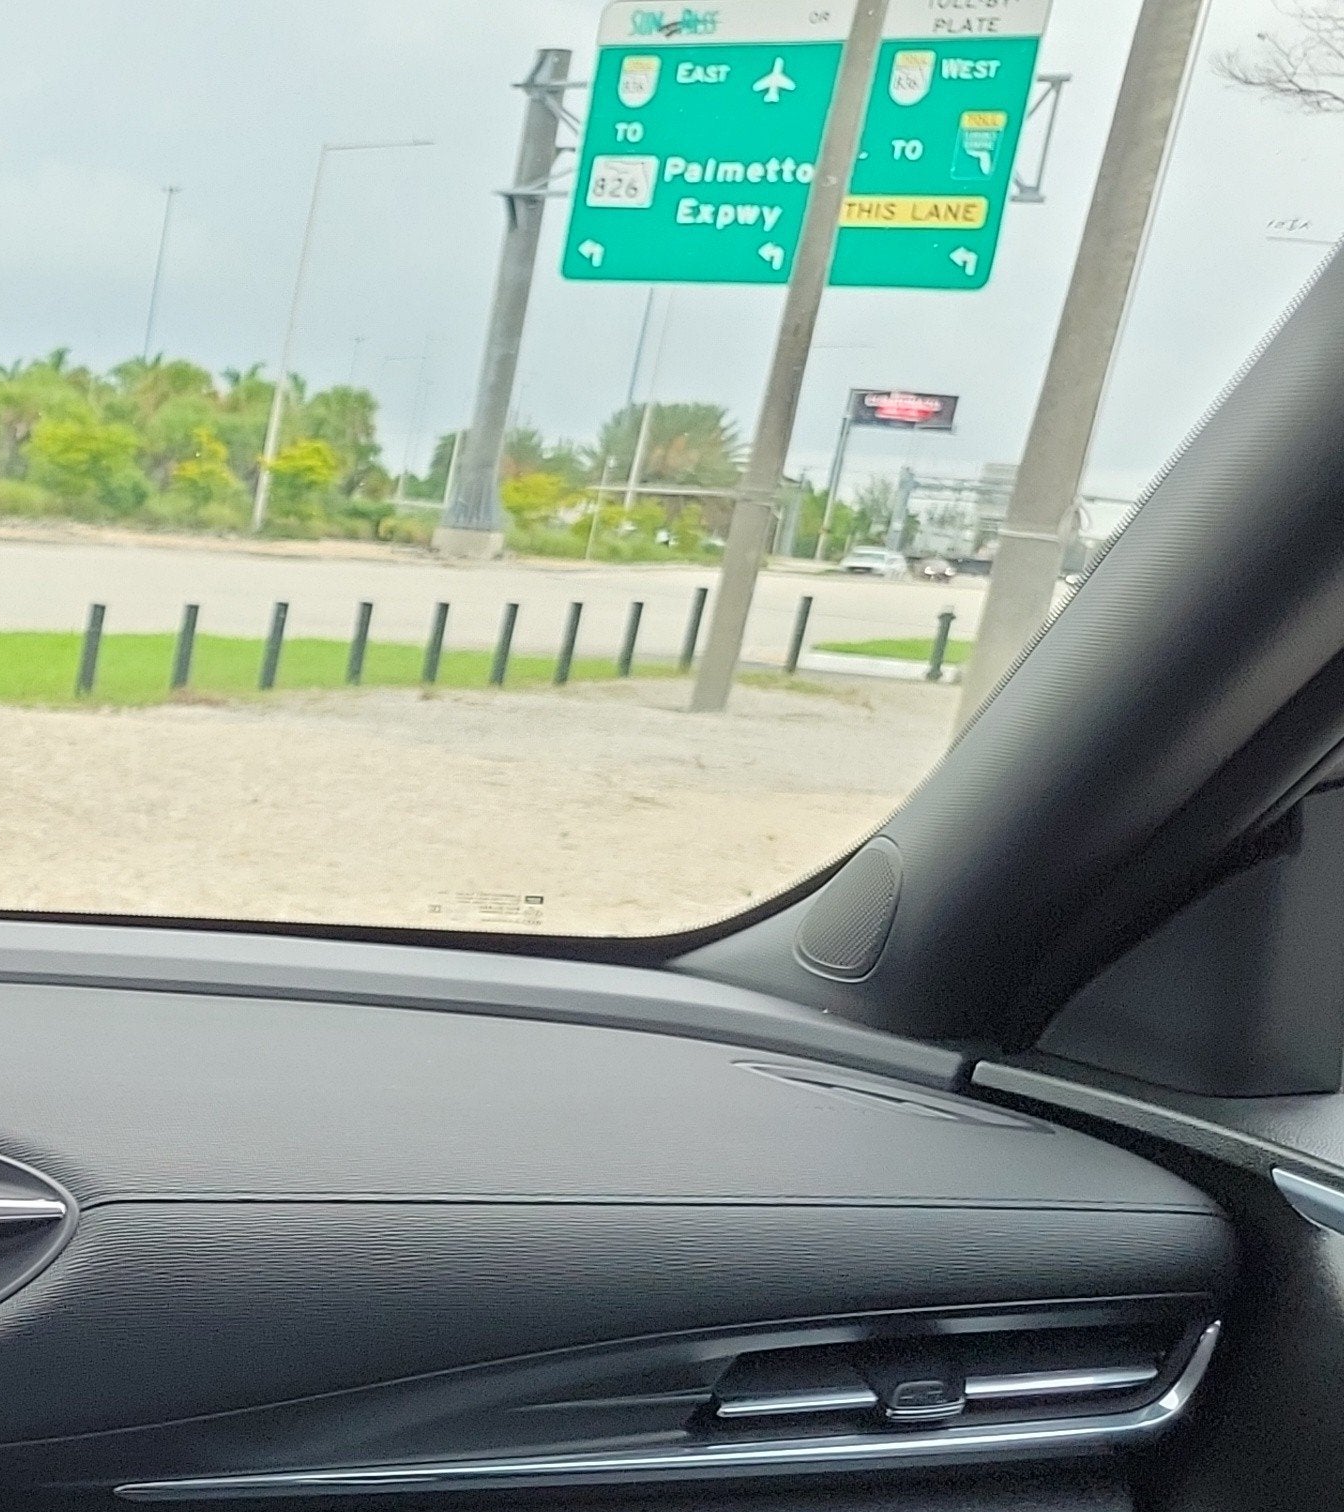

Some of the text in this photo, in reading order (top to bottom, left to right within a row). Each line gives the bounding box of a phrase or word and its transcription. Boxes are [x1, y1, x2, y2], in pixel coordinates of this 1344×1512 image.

[932, 17, 1001, 33] PLATE
[676, 62, 731, 84] EAST
[941, 58, 1001, 79] WEST
[615, 121, 644, 143] TO
[891, 139, 924, 161] TO
[664, 156, 816, 184] Palmetto
[592, 177, 640, 198] 826
[676, 197, 783, 232] Expwy
[846, 202, 979, 223] THIS LANE
